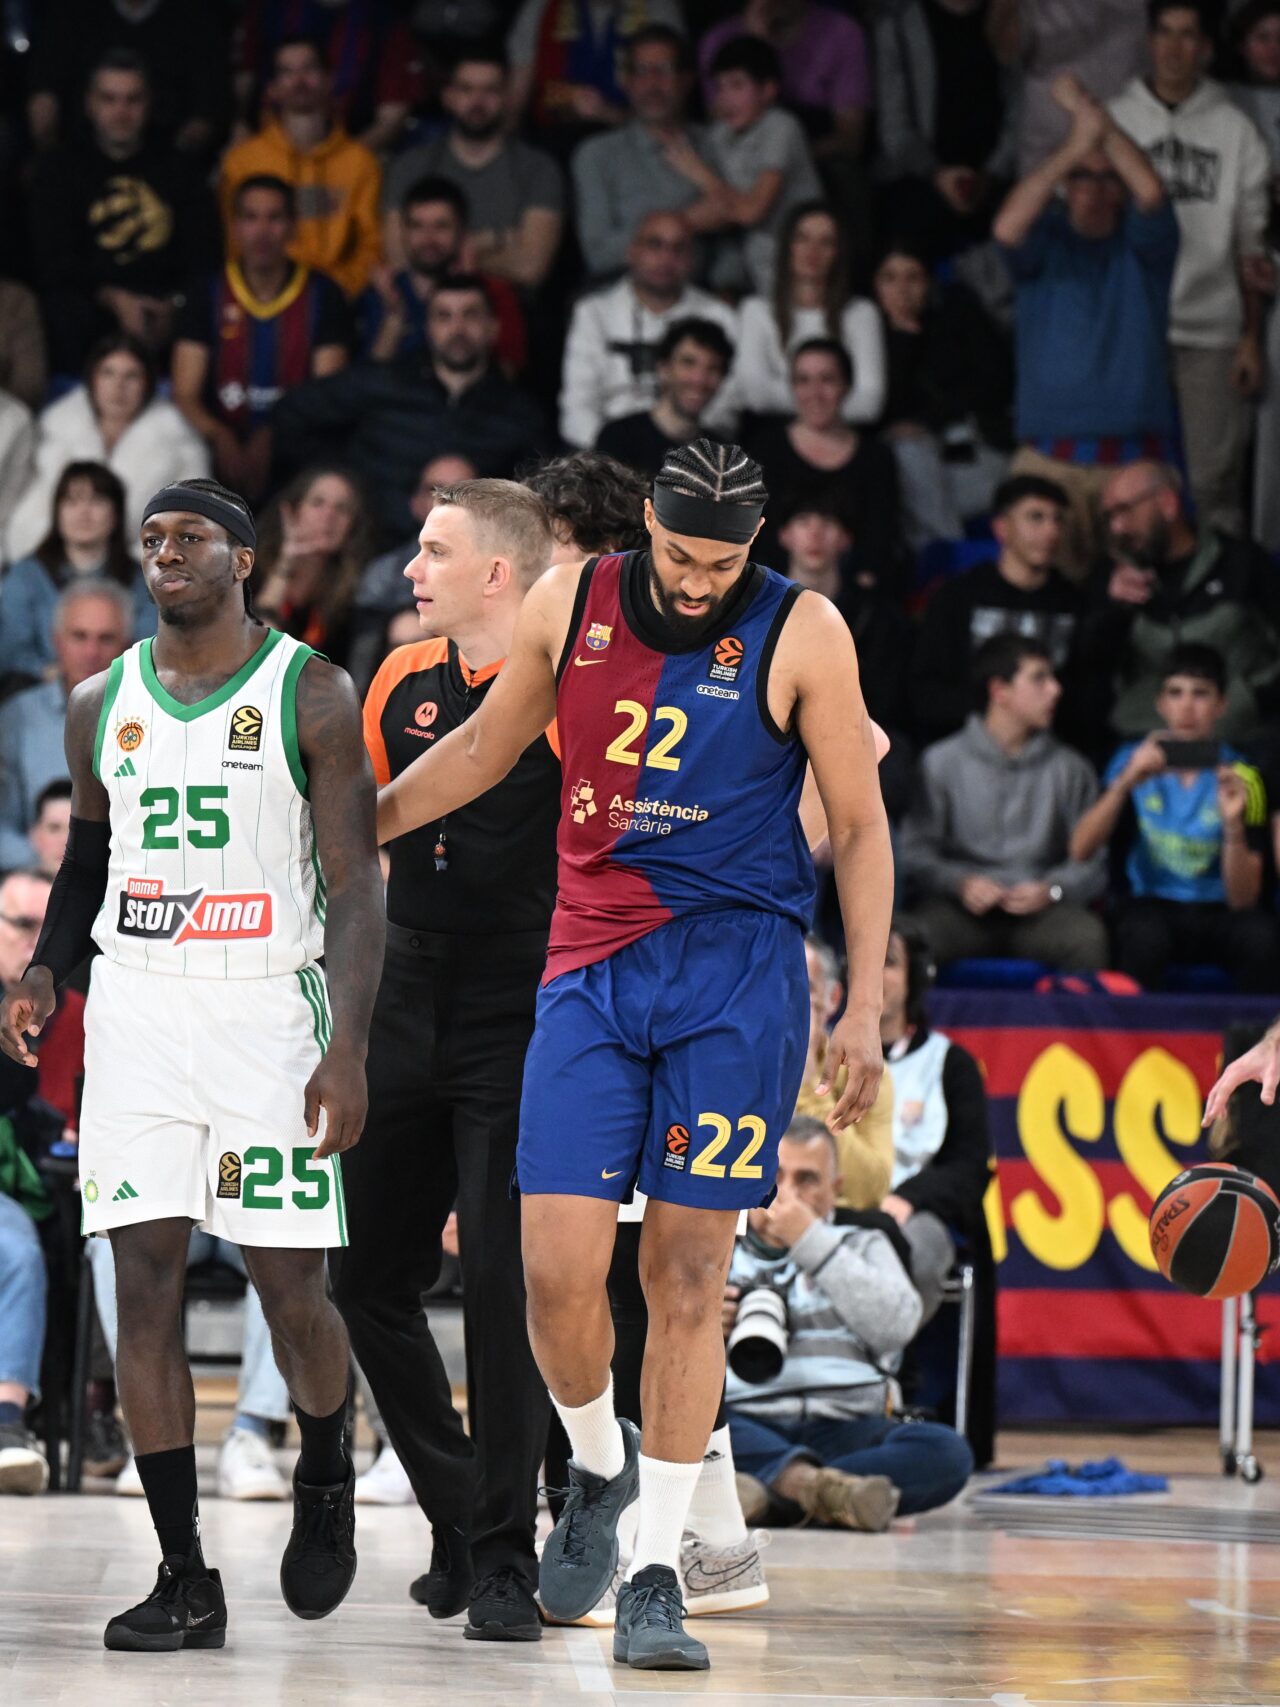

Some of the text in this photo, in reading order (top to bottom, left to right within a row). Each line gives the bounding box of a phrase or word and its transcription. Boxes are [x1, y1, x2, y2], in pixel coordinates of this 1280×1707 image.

[697, 685, 739, 700] oneteam
[404, 727, 435, 739] motorola
[606, 700, 688, 771] 22
[221, 761, 263, 771] oneteam
[140, 786, 230, 849] 25
[608, 794, 709, 821] Assistència
[608, 811, 672, 835] Santària
[129, 880, 159, 895] pame
[690, 1112, 767, 1179] 22
[982, 1042, 1201, 1272] SS
[242, 1146, 330, 1210] 25
